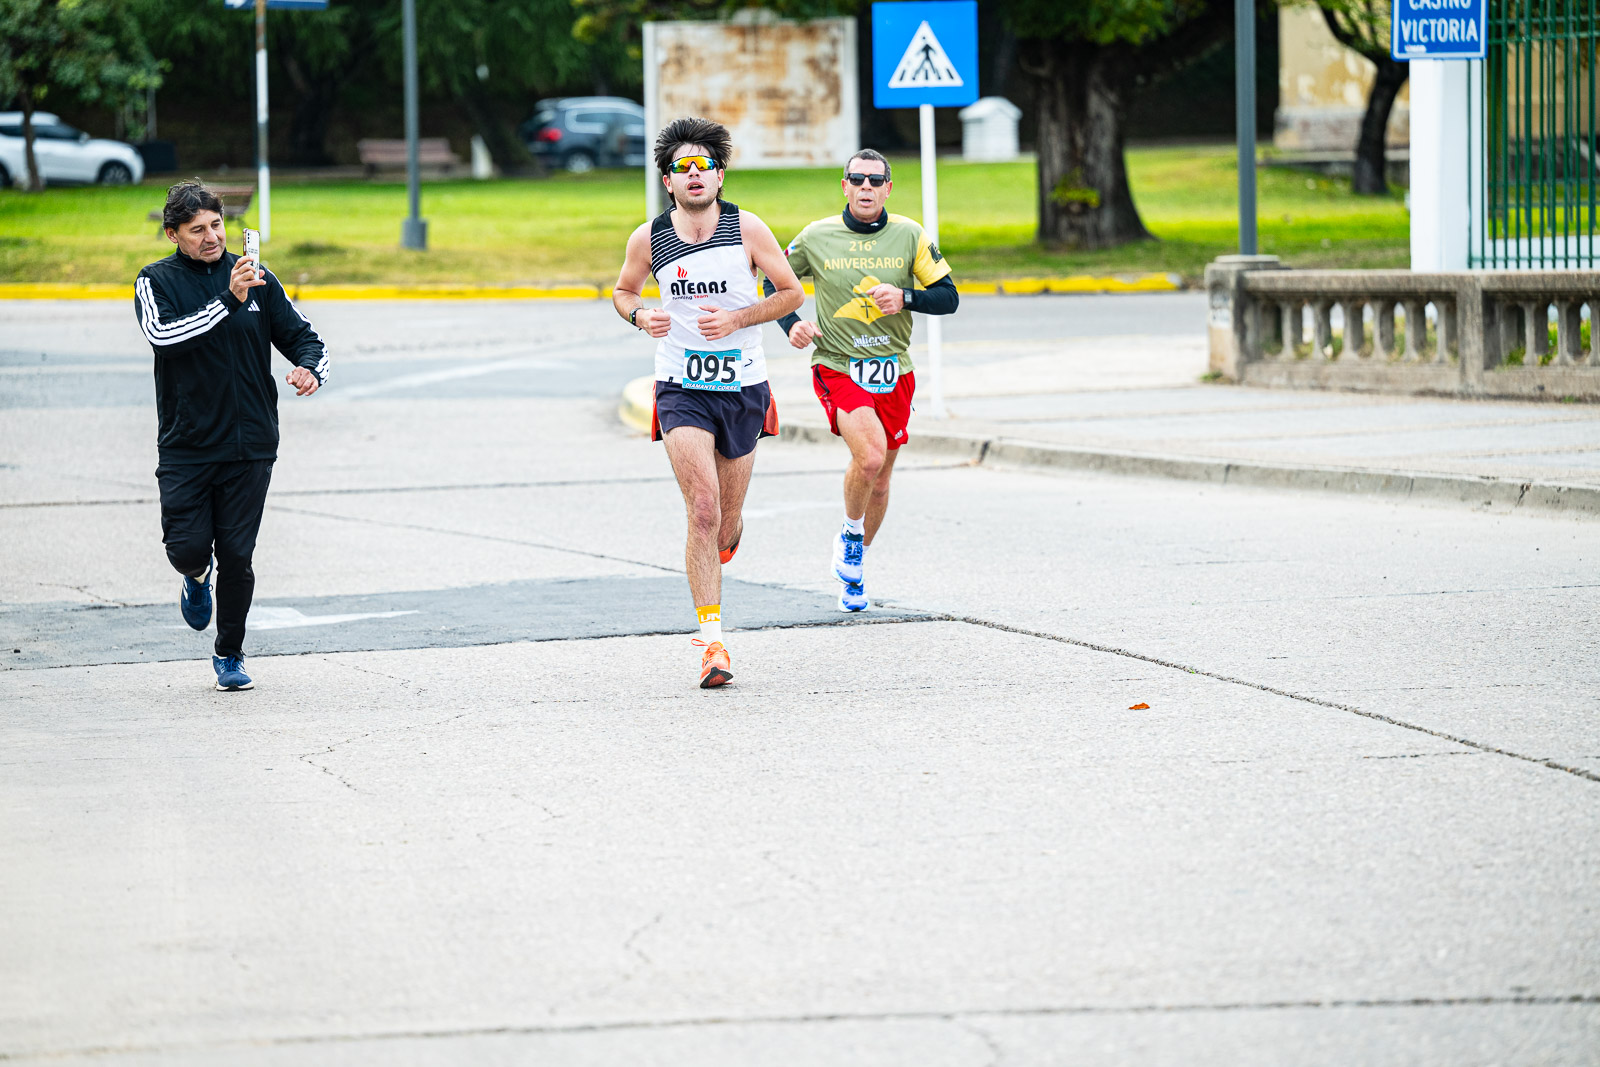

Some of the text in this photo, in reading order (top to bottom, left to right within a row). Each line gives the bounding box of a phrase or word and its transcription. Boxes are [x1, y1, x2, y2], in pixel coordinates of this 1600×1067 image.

[1401, 18, 1478, 43] VICTORIA
[849, 240, 877, 252] 216°
[824, 257, 905, 271] ANIVERSARIO
[686, 353, 736, 384] 095
[854, 359, 895, 385] 120
[685, 382, 717, 390] DIAMANTE
